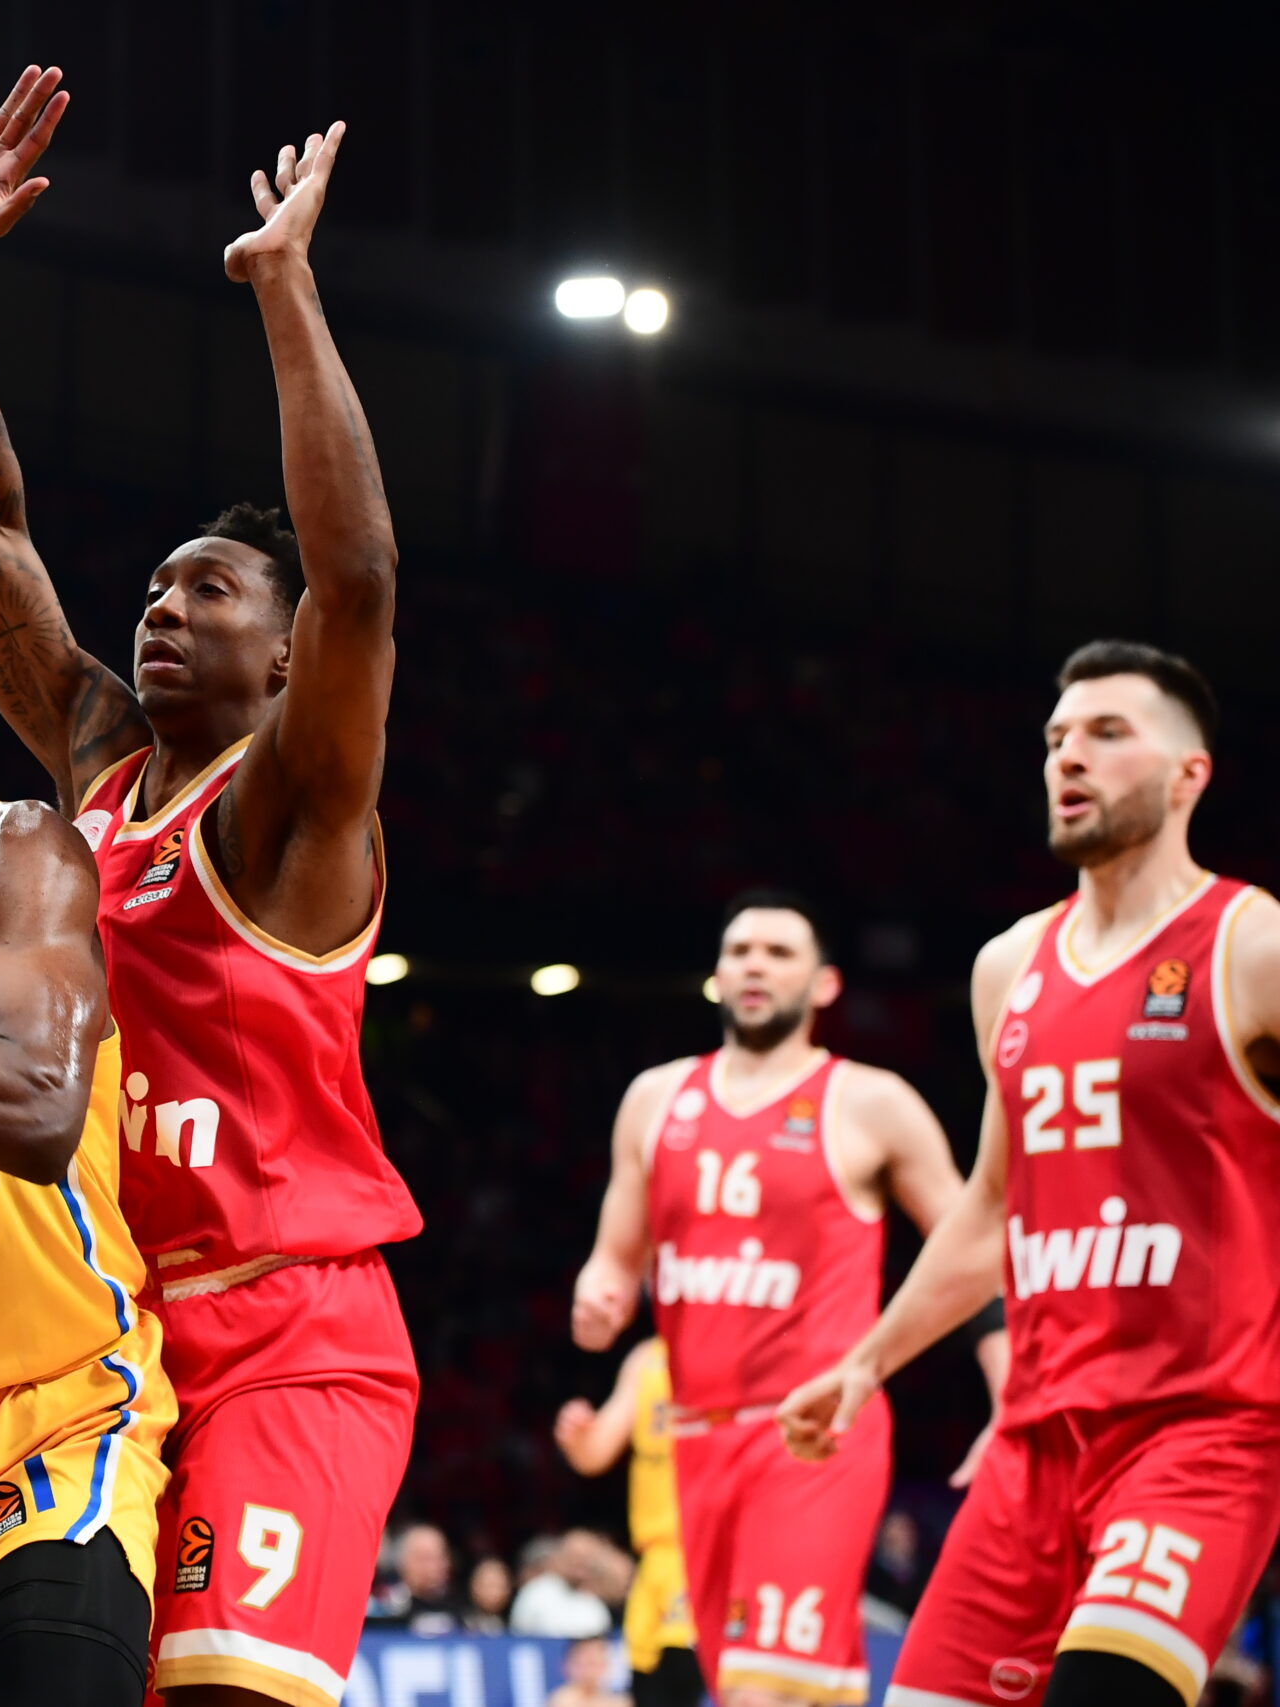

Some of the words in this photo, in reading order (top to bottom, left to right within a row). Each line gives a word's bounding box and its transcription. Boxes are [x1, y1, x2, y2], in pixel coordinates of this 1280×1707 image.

[1021, 1058, 1122, 1156] 25
[696, 1149, 762, 1217] 16
[657, 1237, 801, 1311] bwin
[1008, 1196, 1182, 1301] bwin
[237, 1502, 304, 1611] 9
[1085, 1518, 1203, 1621] 25
[755, 1582, 824, 1656] 16
